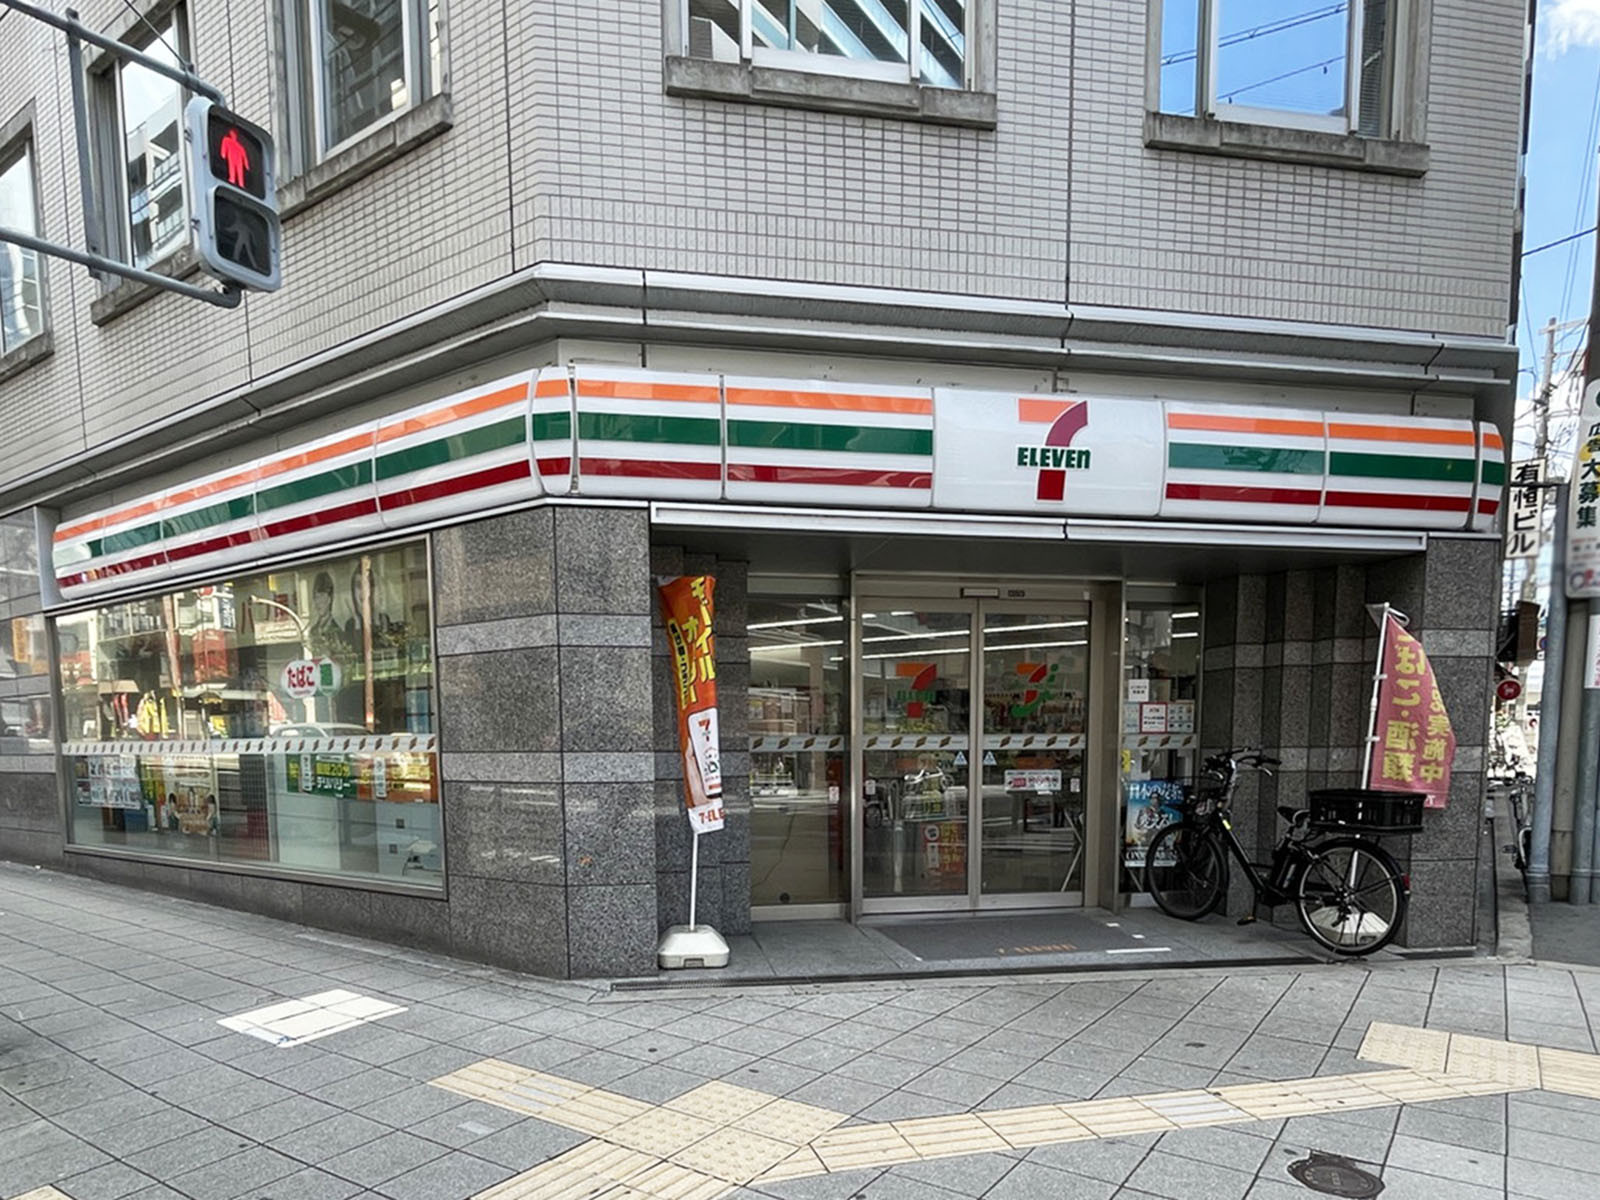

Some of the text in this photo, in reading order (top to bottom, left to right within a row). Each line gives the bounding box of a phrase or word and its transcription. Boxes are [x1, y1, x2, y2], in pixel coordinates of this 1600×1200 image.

[1509, 463, 1540, 555] 有恒ビル
[287, 665, 316, 688] たばこ
